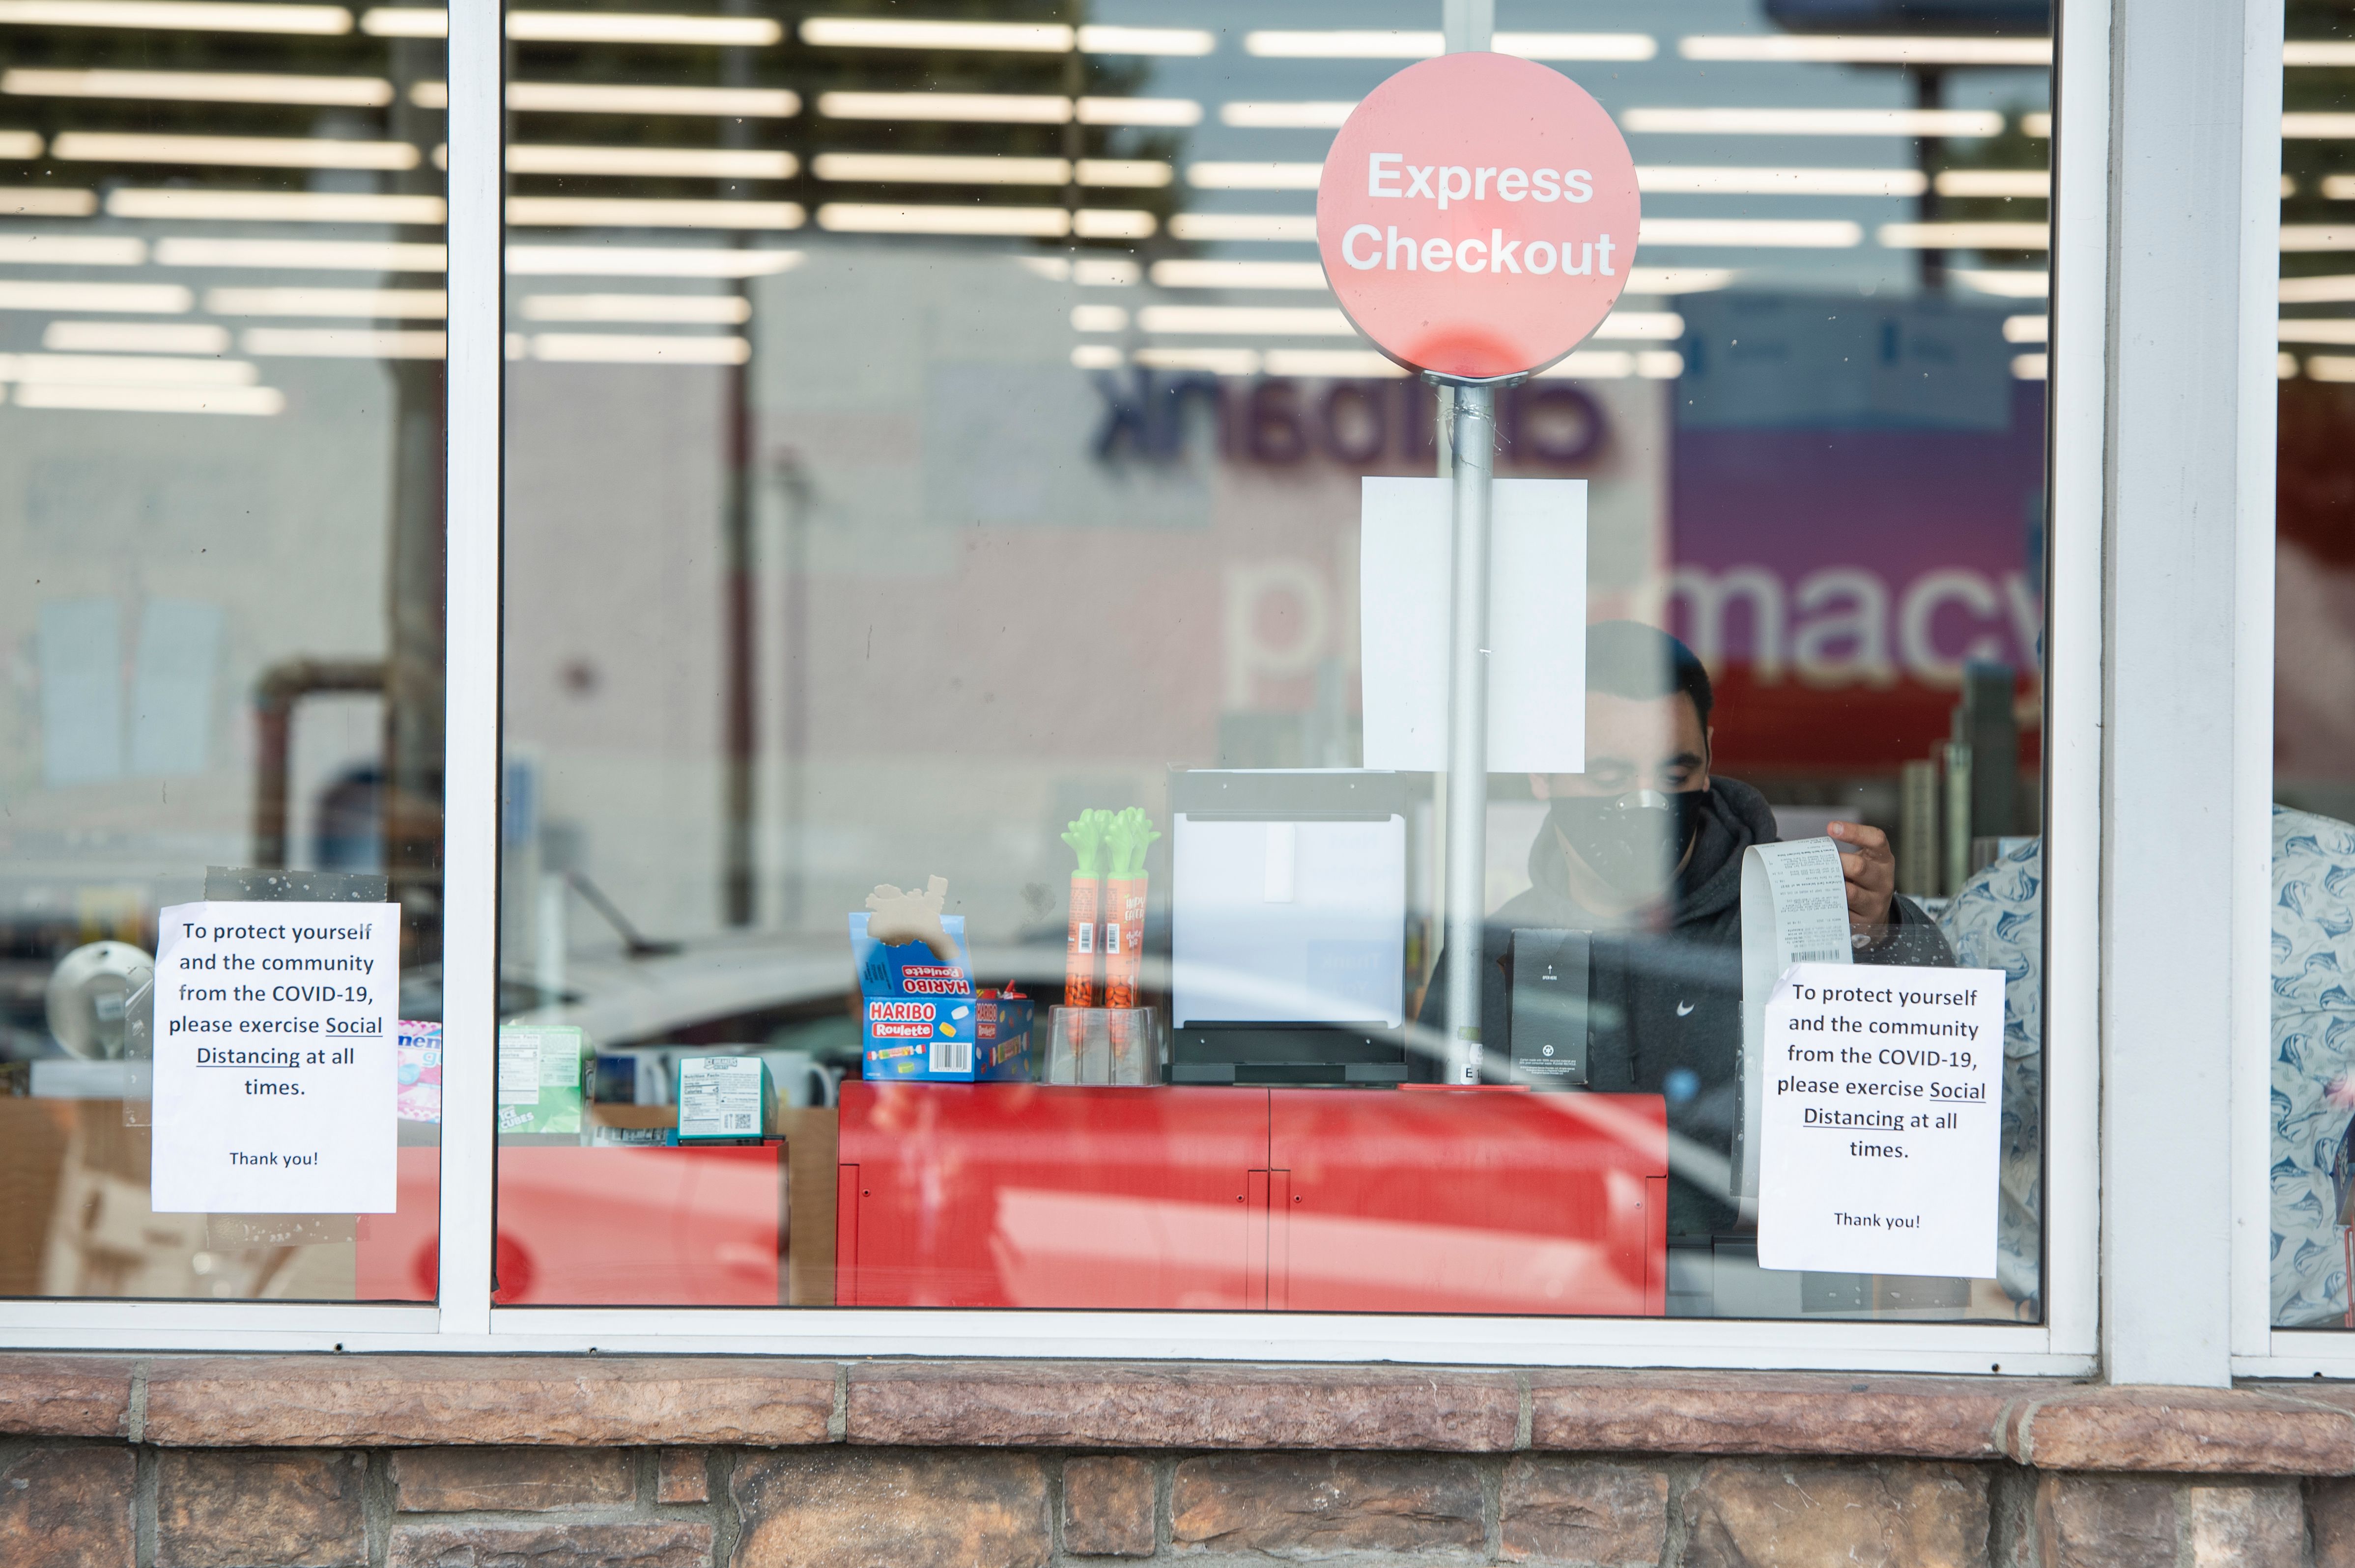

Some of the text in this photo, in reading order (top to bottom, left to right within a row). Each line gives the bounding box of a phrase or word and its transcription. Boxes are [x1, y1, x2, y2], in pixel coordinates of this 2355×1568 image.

[1368, 152, 1594, 210] Express
[1341, 223, 1616, 276] Checkout
[182, 923, 372, 943] To protect yourself
[180, 953, 374, 975] and the community
[179, 984, 372, 1005] from the COVID-19,
[904, 979, 970, 994] HARIBO
[1792, 983, 1978, 1008] To protect yourself
[869, 1002, 936, 1021] HARIBO
[170, 1015, 383, 1036] please exercise Social
[876, 1024, 931, 1036] Roulette
[1789, 1015, 1979, 1041] and the community
[398, 1035, 441, 1049] men
[197, 1047, 354, 1067] Distancing at all
[1788, 1044, 1977, 1071] from the COVID-19,
[1466, 1068, 1473, 1078] E
[245, 1078, 305, 1095] times.
[1778, 1075, 1986, 1101] please exercise Social
[500, 1112, 535, 1129] CUBES
[1804, 1108, 1957, 1131] Distancing at all
[229, 1151, 317, 1168] Thank you!
[1850, 1141, 1908, 1158] times.
[1834, 1212, 1920, 1230] Thank you!
